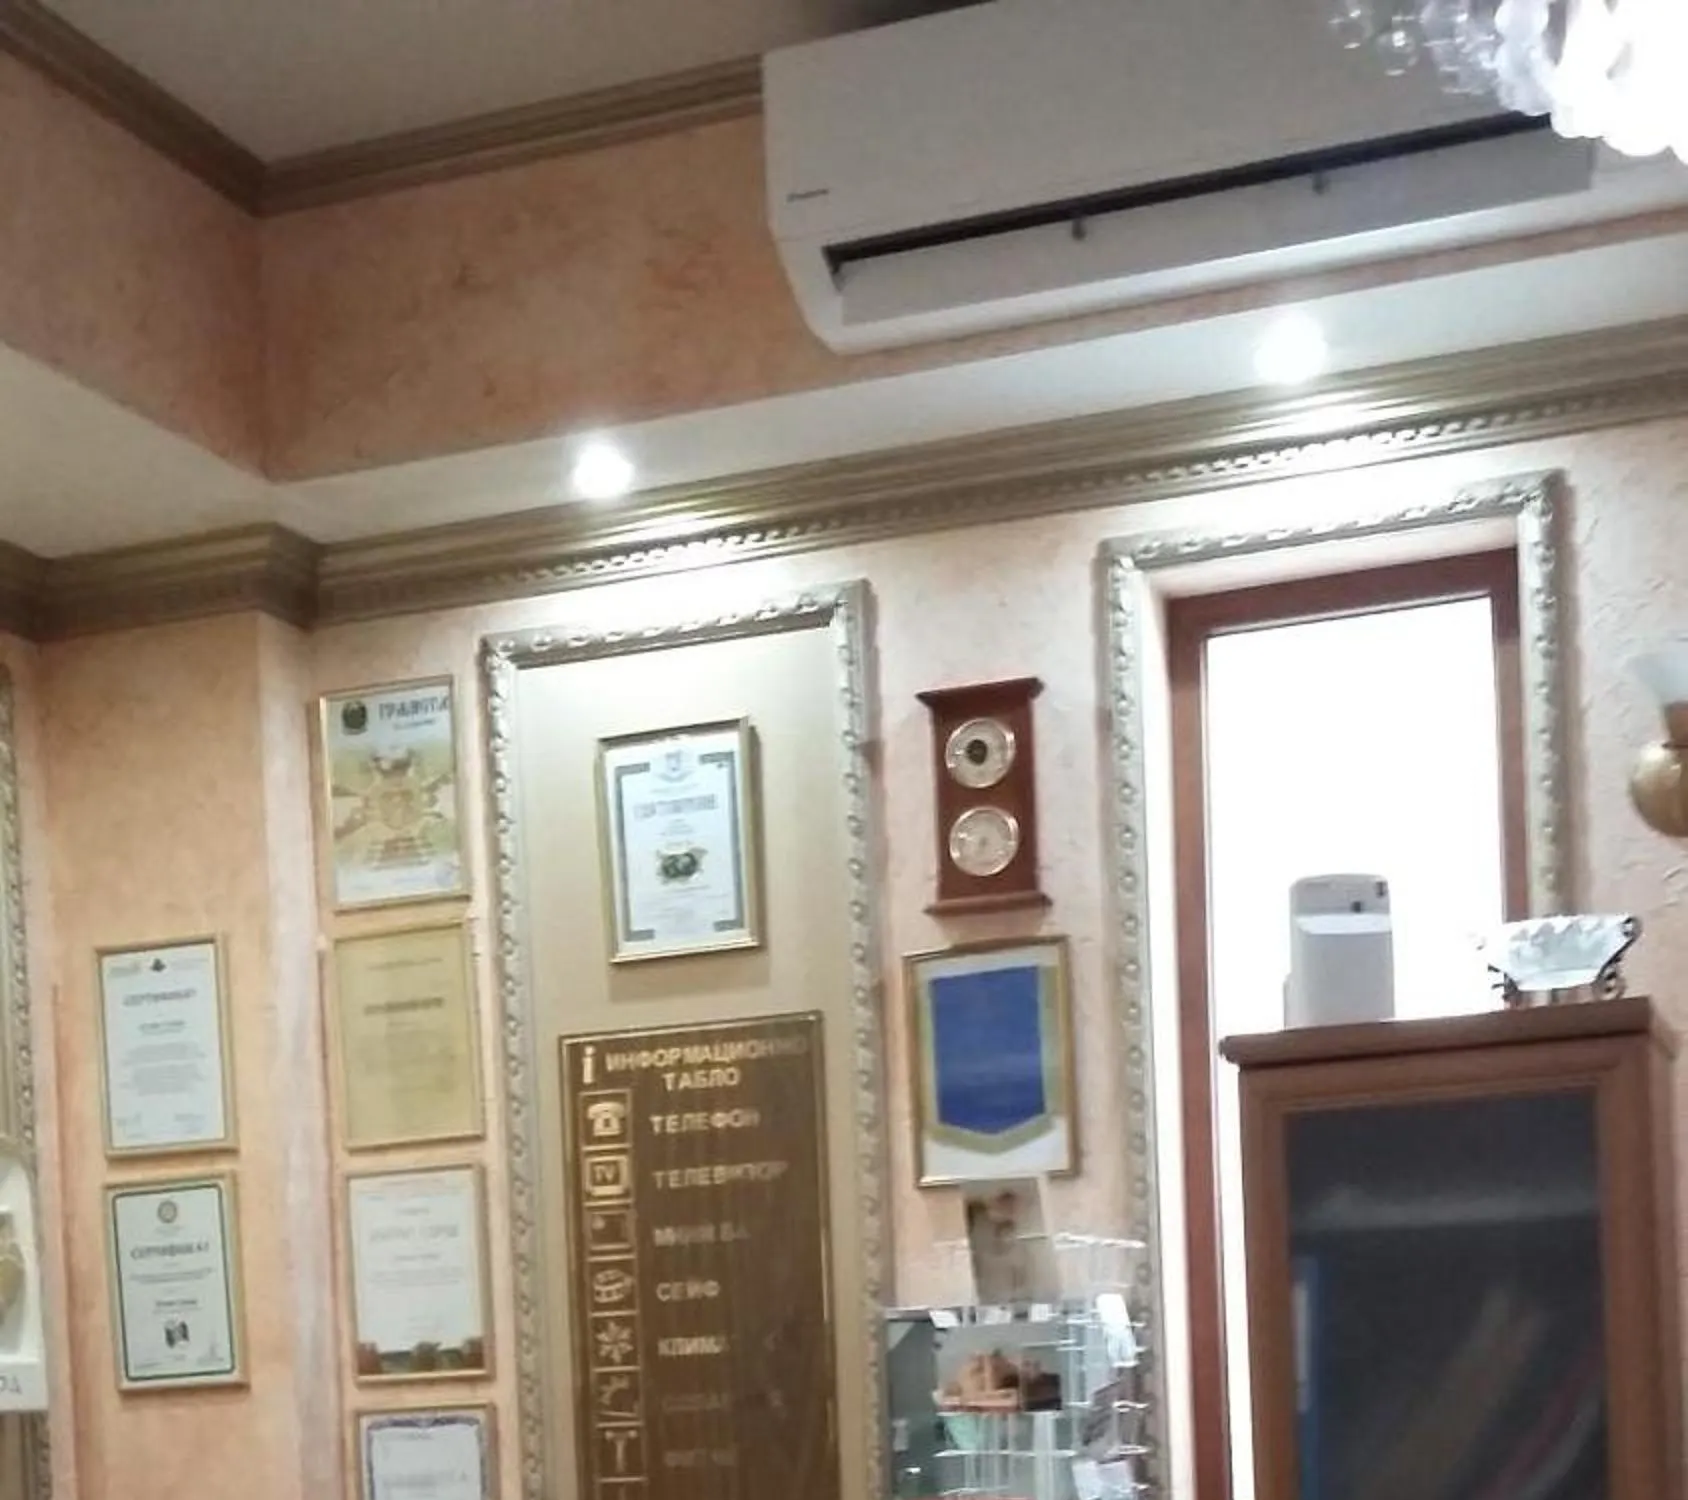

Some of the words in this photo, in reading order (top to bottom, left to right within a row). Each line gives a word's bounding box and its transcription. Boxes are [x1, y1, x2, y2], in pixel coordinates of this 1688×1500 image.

[662, 1066, 741, 1092] ТАБЛО
[650, 1108, 761, 1135] ТЕЛЕФОН
[593, 1164, 616, 1182] TV
